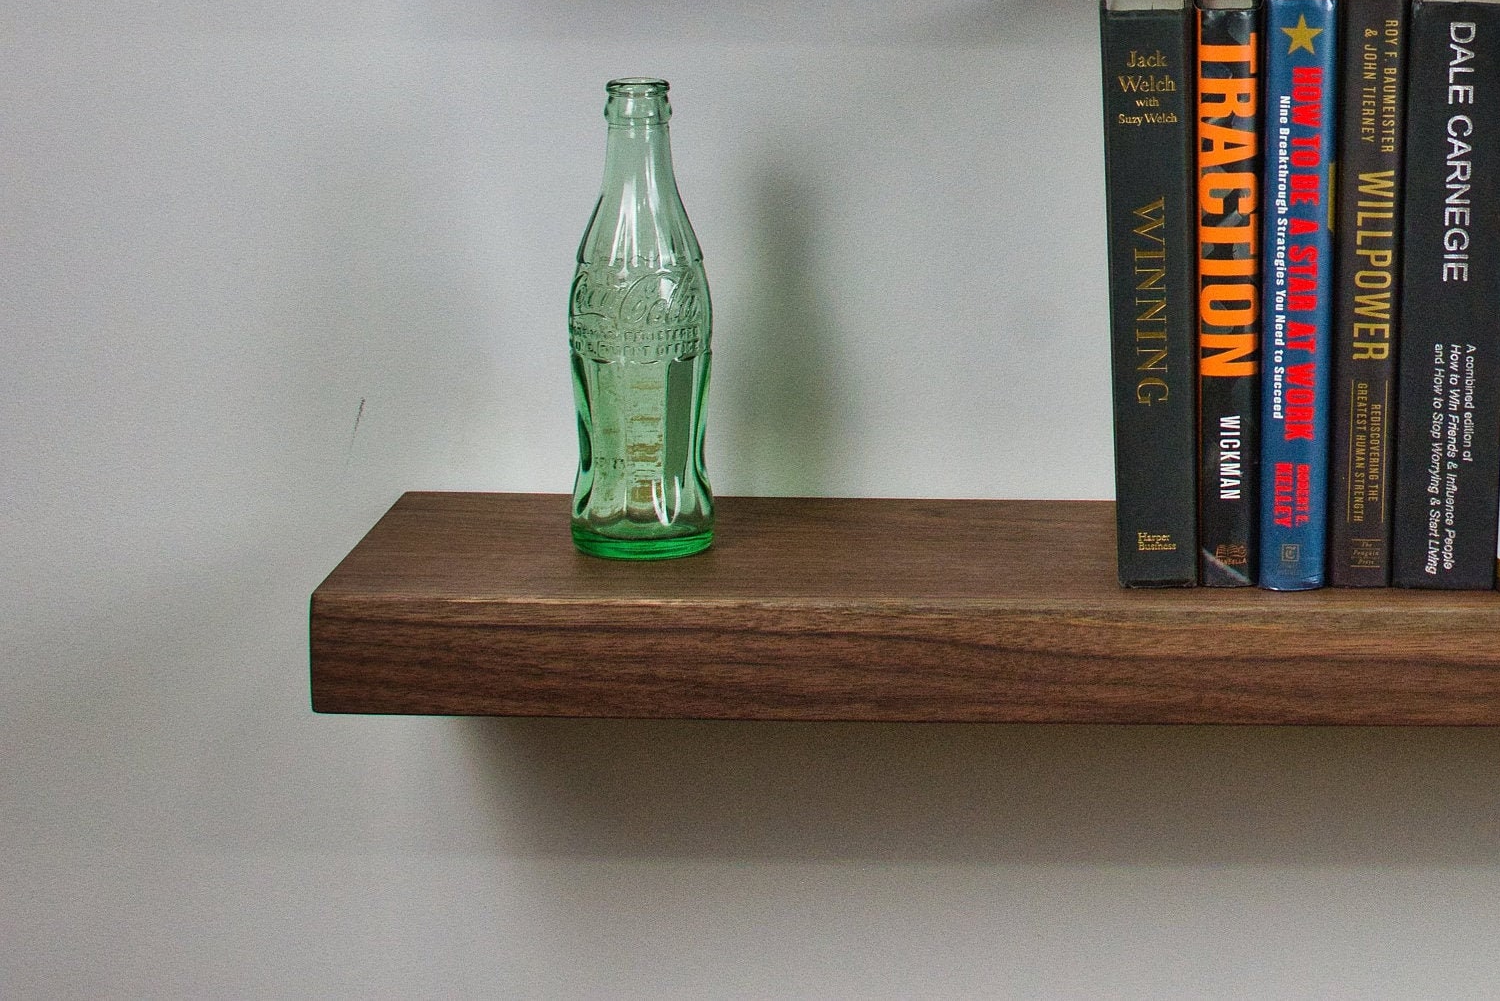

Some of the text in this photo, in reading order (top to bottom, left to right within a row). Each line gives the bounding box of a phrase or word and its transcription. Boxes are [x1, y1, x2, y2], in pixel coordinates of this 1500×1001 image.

[1119, 75, 1177, 93] Welch
[1126, 50, 1168, 68] Jack
[1135, 98, 1160, 108] with
[1361, 28, 1378, 143] & JOHN TIERNEY
[1381, 19, 1399, 153] ROY F. BAUMEISTER
[1118, 113, 1178, 127] Suzy Welch
[1442, 21, 1476, 282] DALE CARNEGIE
[1200, 33, 1259, 377] TRACTION
[1273, 95, 1291, 419] Nine Breakthrough Strategies You Need to Succeed
[1284, 66, 1323, 441] HOW TO BE A STAR AT WORK
[1132, 196, 1169, 406] WINNING
[1352, 170, 1395, 360] WILLPOWER
[1219, 415, 1241, 499] WICKMAN
[1353, 383, 1368, 522] GREATEST HUMAN STRENGTH
[1367, 404, 1381, 502] REDISCOVERING THE
[1425, 344, 1444, 575] and How to Stop Worrying & Start Living
[1442, 344, 1462, 570] How to Win Friends & Influence People
[1462, 344, 1477, 461] A combined edition of
[1137, 532, 1171, 544] Harper
[1137, 541, 1178, 551] Business
[1273, 462, 1293, 528] KELLEY
